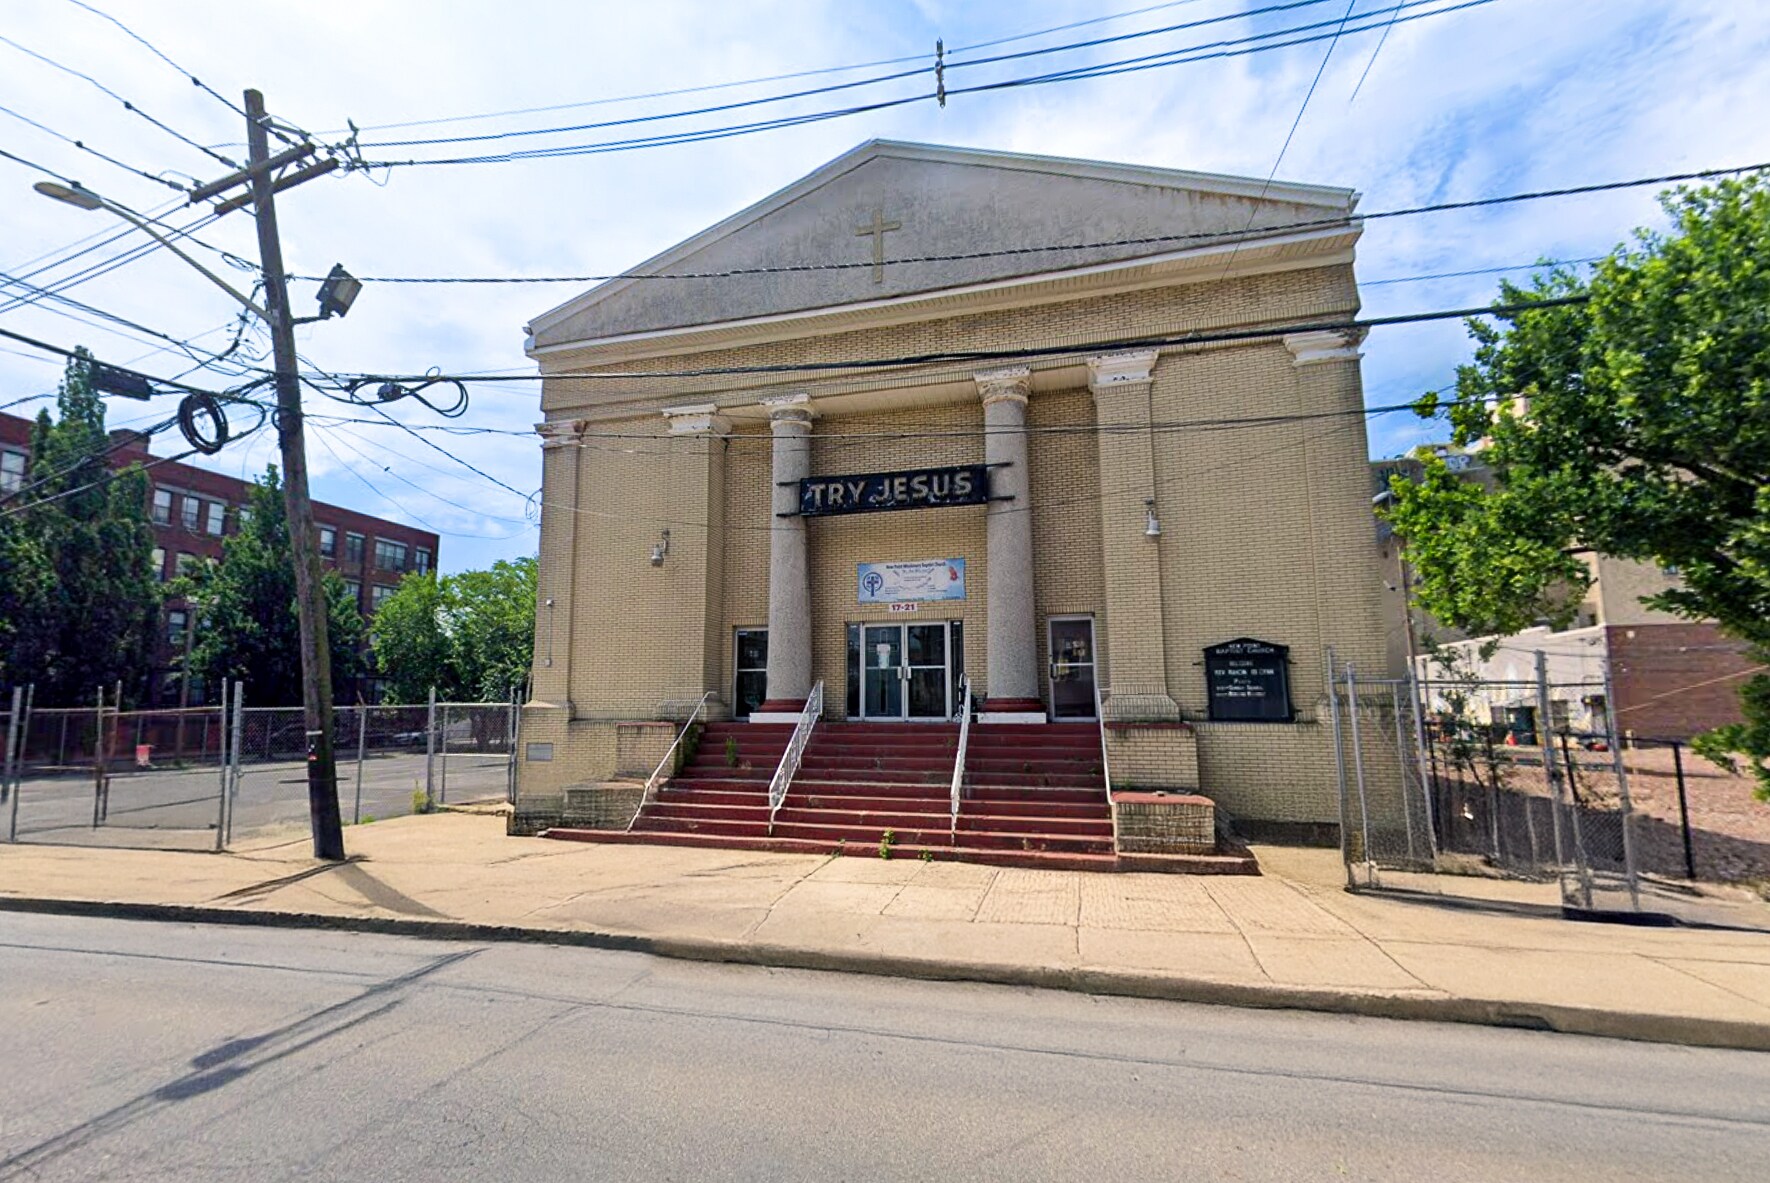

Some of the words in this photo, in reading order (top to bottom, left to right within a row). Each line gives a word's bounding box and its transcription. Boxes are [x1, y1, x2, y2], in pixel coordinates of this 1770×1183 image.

[809, 481, 866, 507] TRY
[872, 472, 972, 502] JESUS
[891, 603, 915, 611] 17-21
